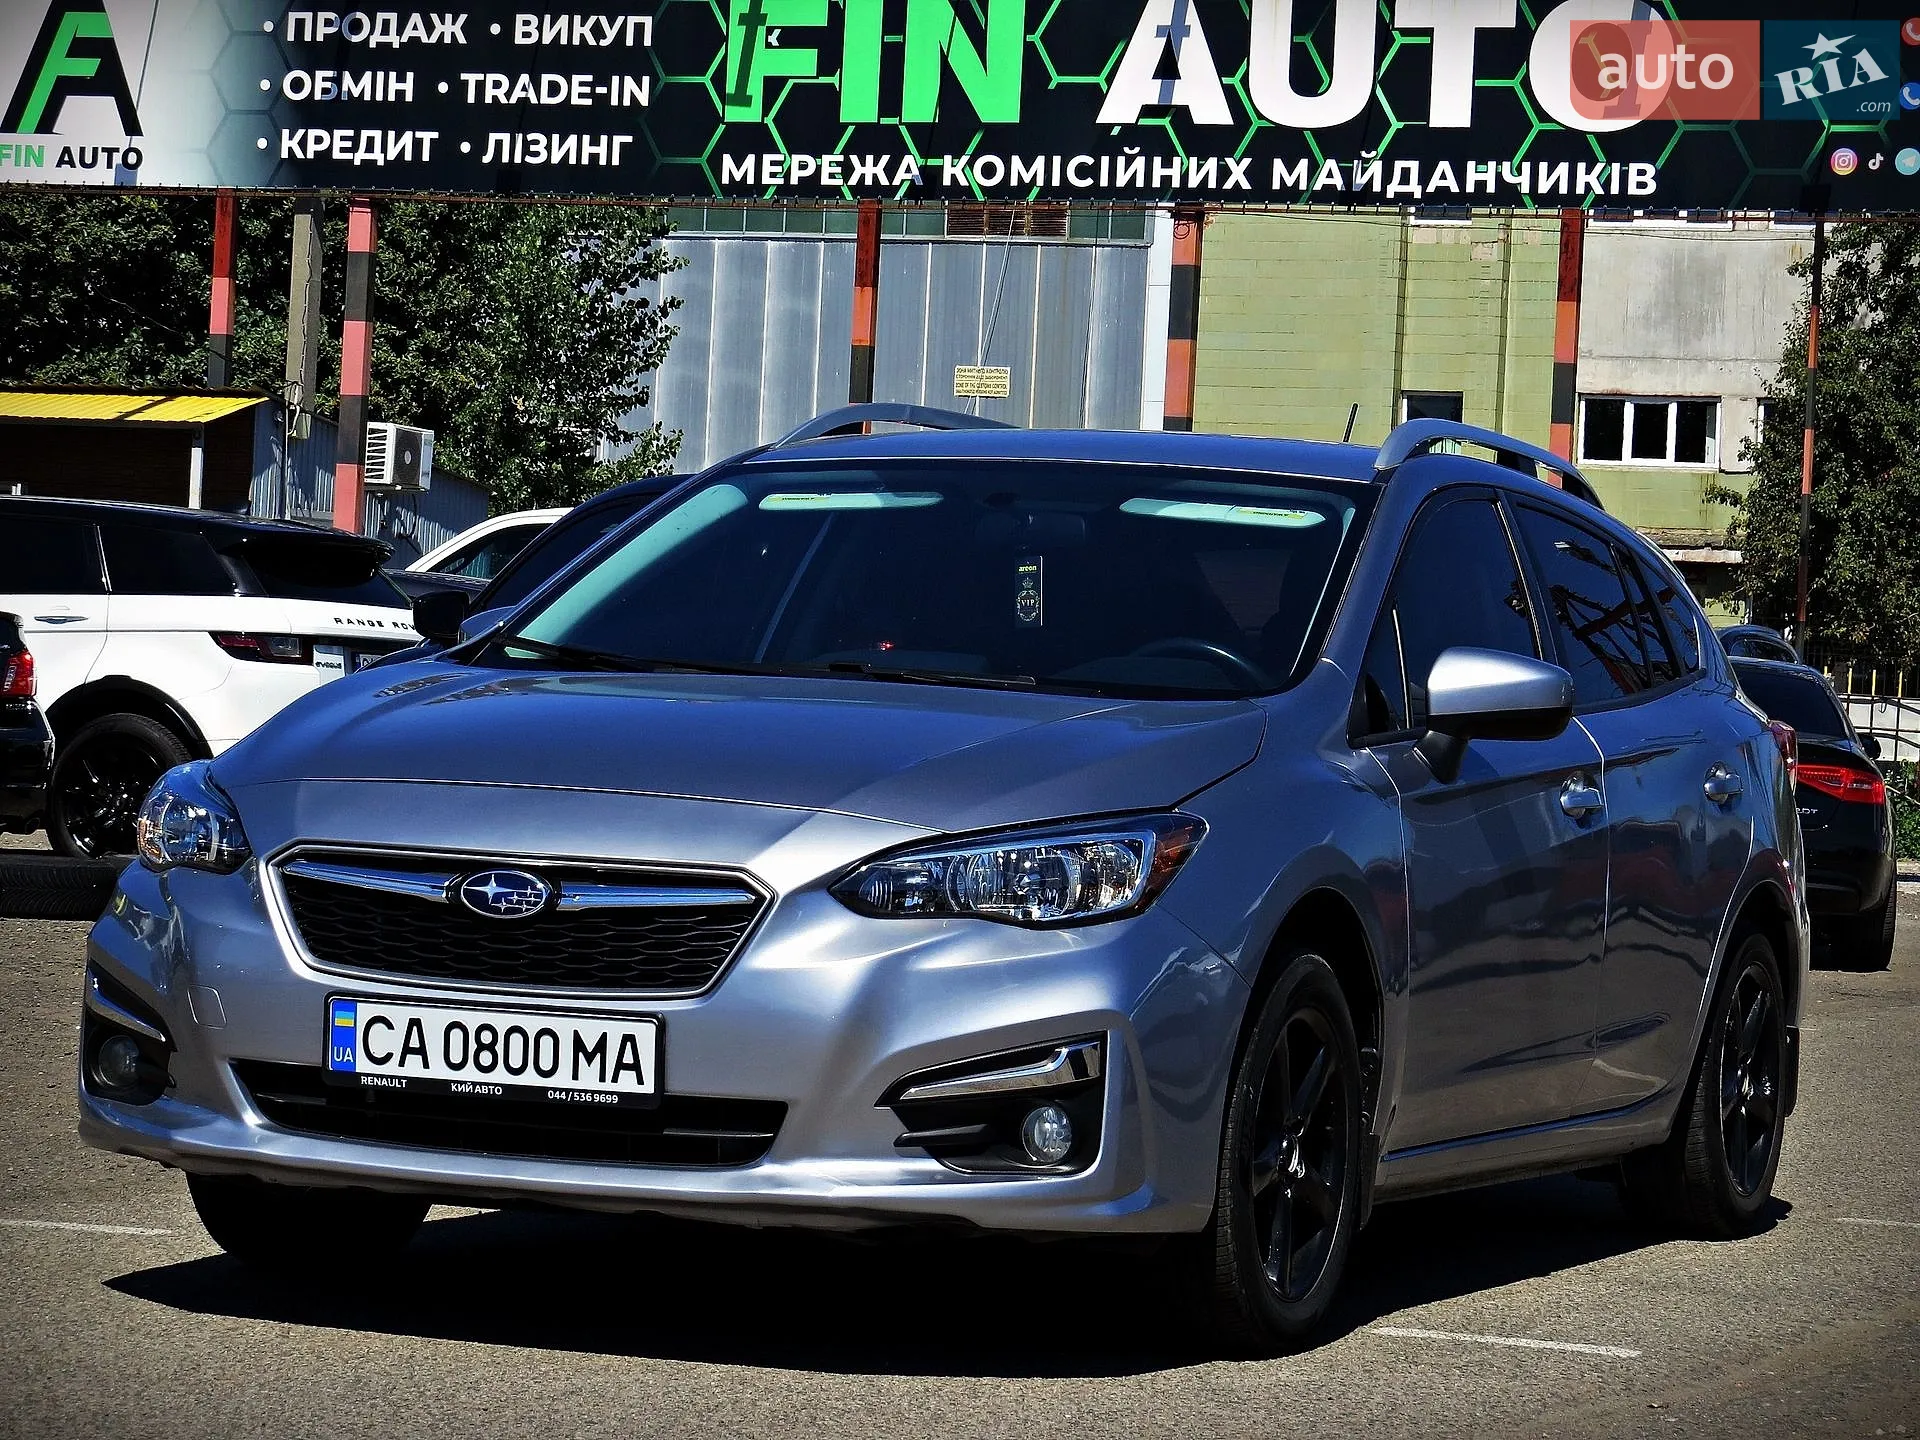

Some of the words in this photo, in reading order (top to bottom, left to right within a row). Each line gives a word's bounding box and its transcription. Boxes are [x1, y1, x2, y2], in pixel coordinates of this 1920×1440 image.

[287, 12, 467, 48] ПРОДАЖ
[515, 14, 653, 46] ВИКУП
[724, 0, 1025, 123] FIN
[1095, 0, 1674, 132] AUTO
[283, 70, 413, 101] ОБМІН
[461, 73, 650, 106] TRADE-IN
[0, 145, 45, 167] FIN
[56, 146, 143, 170] AUTO
[281, 129, 438, 165] КРЕДИТ
[482, 133, 632, 166] ЛІЗИНГ
[721, 153, 921, 186] МЕРЕЖА
[943, 147, 1252, 190] КОМІСІЙНИХ
[1272, 151, 1657, 198] МАЙДАНЧИКІВ
[334, 617, 384, 628] RANGE
[392, 621, 417, 631] ROV
[333, 1046, 354, 1062] UA
[362, 1014, 430, 1070] CA
[443, 1020, 560, 1079] 0800
[571, 1028, 645, 1086] MA
[360, 1075, 408, 1088] RENAULT
[450, 1082, 473, 1093] КИЙ
[474, 1084, 503, 1096] АВТО
